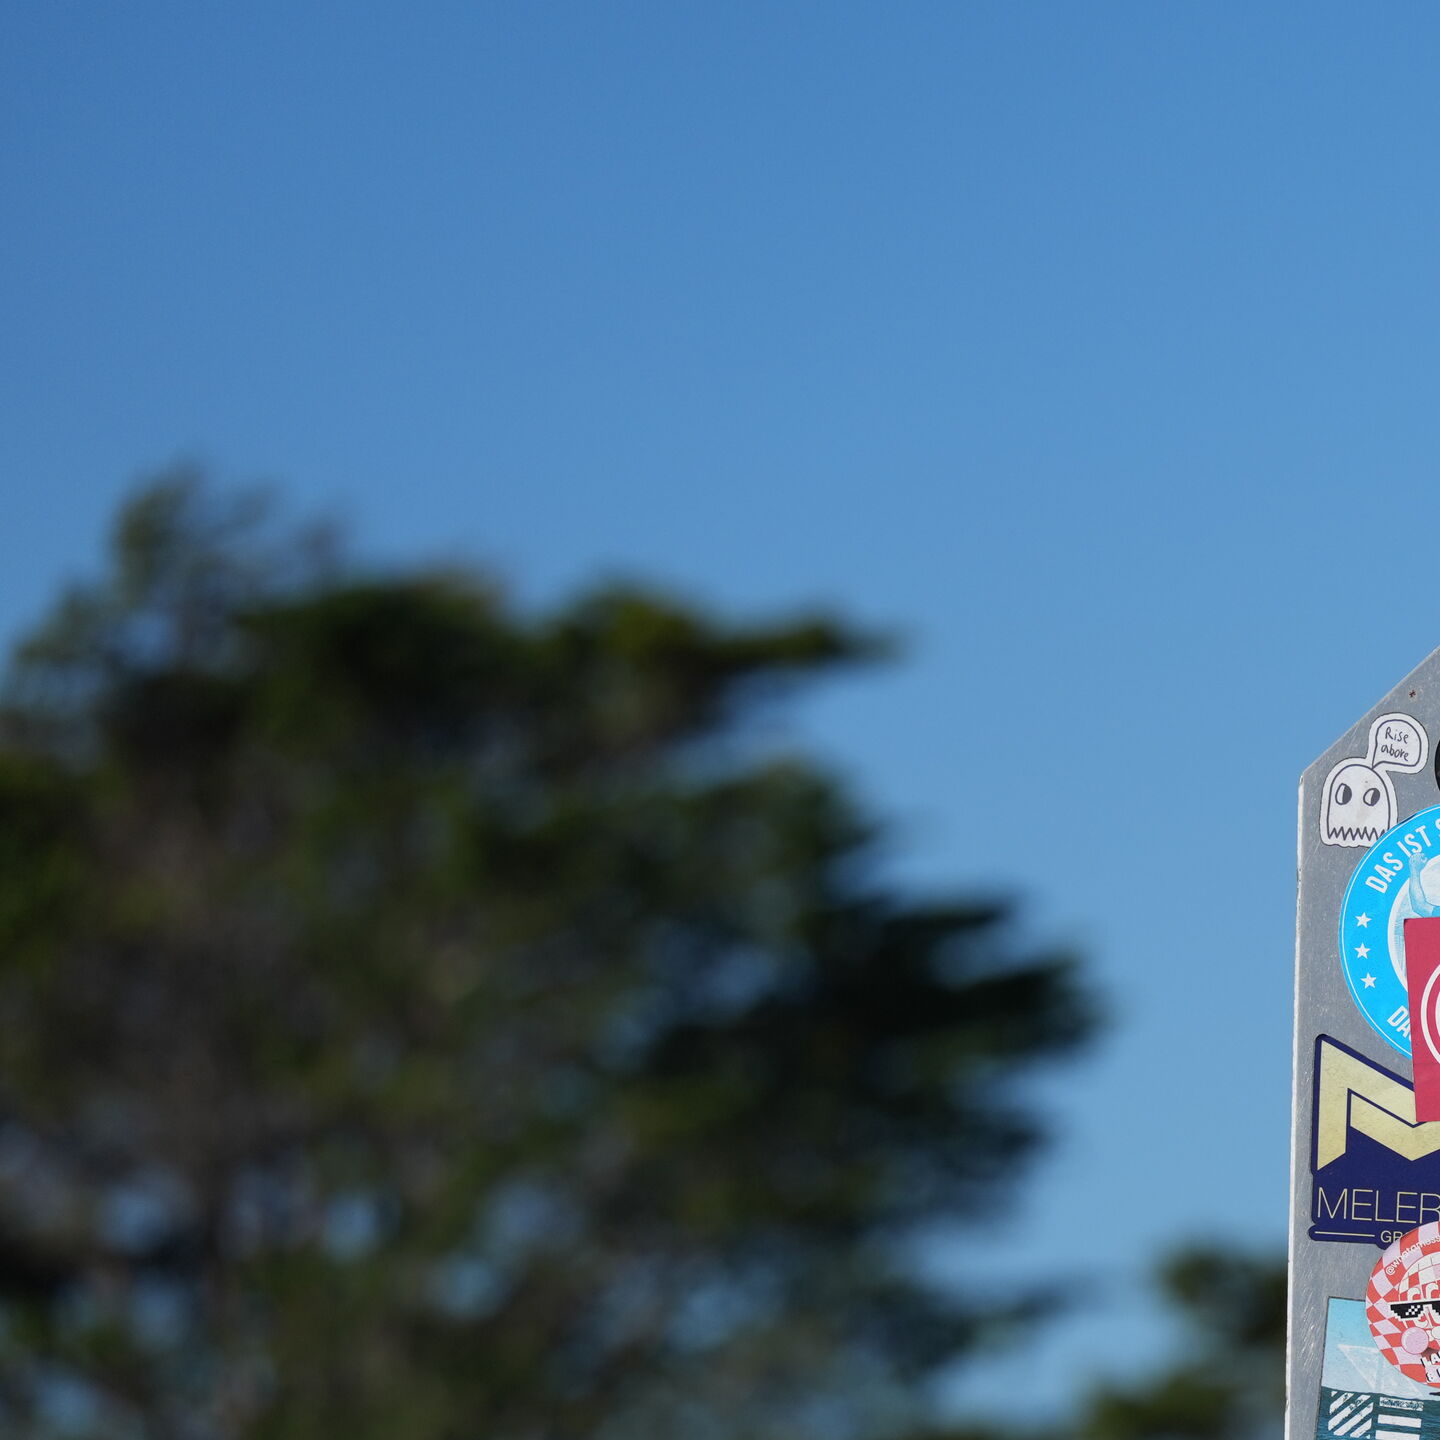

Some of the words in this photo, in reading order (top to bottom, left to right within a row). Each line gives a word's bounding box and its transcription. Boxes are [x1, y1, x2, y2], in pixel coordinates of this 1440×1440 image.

[1383, 726, 1409, 745] Rise
[1380, 744, 1410, 763] above
[1365, 852, 1404, 894] DAS
[1396, 825, 1435, 858] IST
